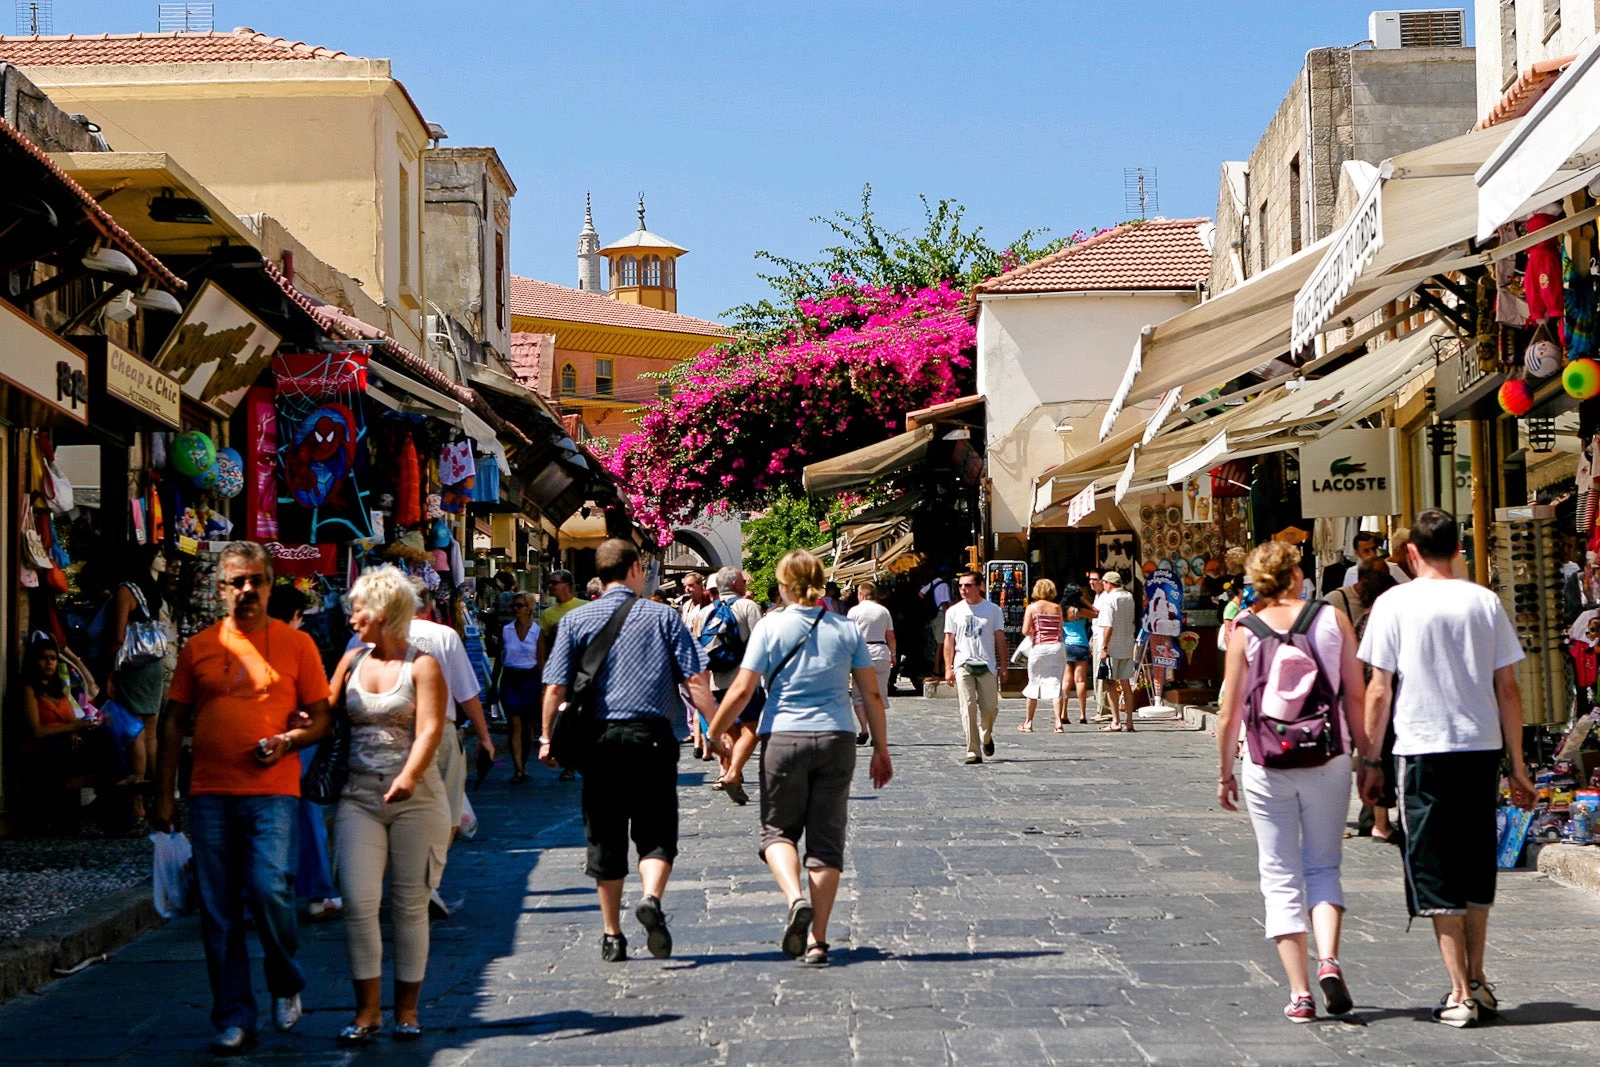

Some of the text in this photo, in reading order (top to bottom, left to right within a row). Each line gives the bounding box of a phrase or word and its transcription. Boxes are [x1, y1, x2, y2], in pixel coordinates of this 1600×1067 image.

[110, 349, 177, 404] Cheap & Chic
[1312, 477, 1386, 492] LACOSTE
[264, 541, 321, 560] Barbie
